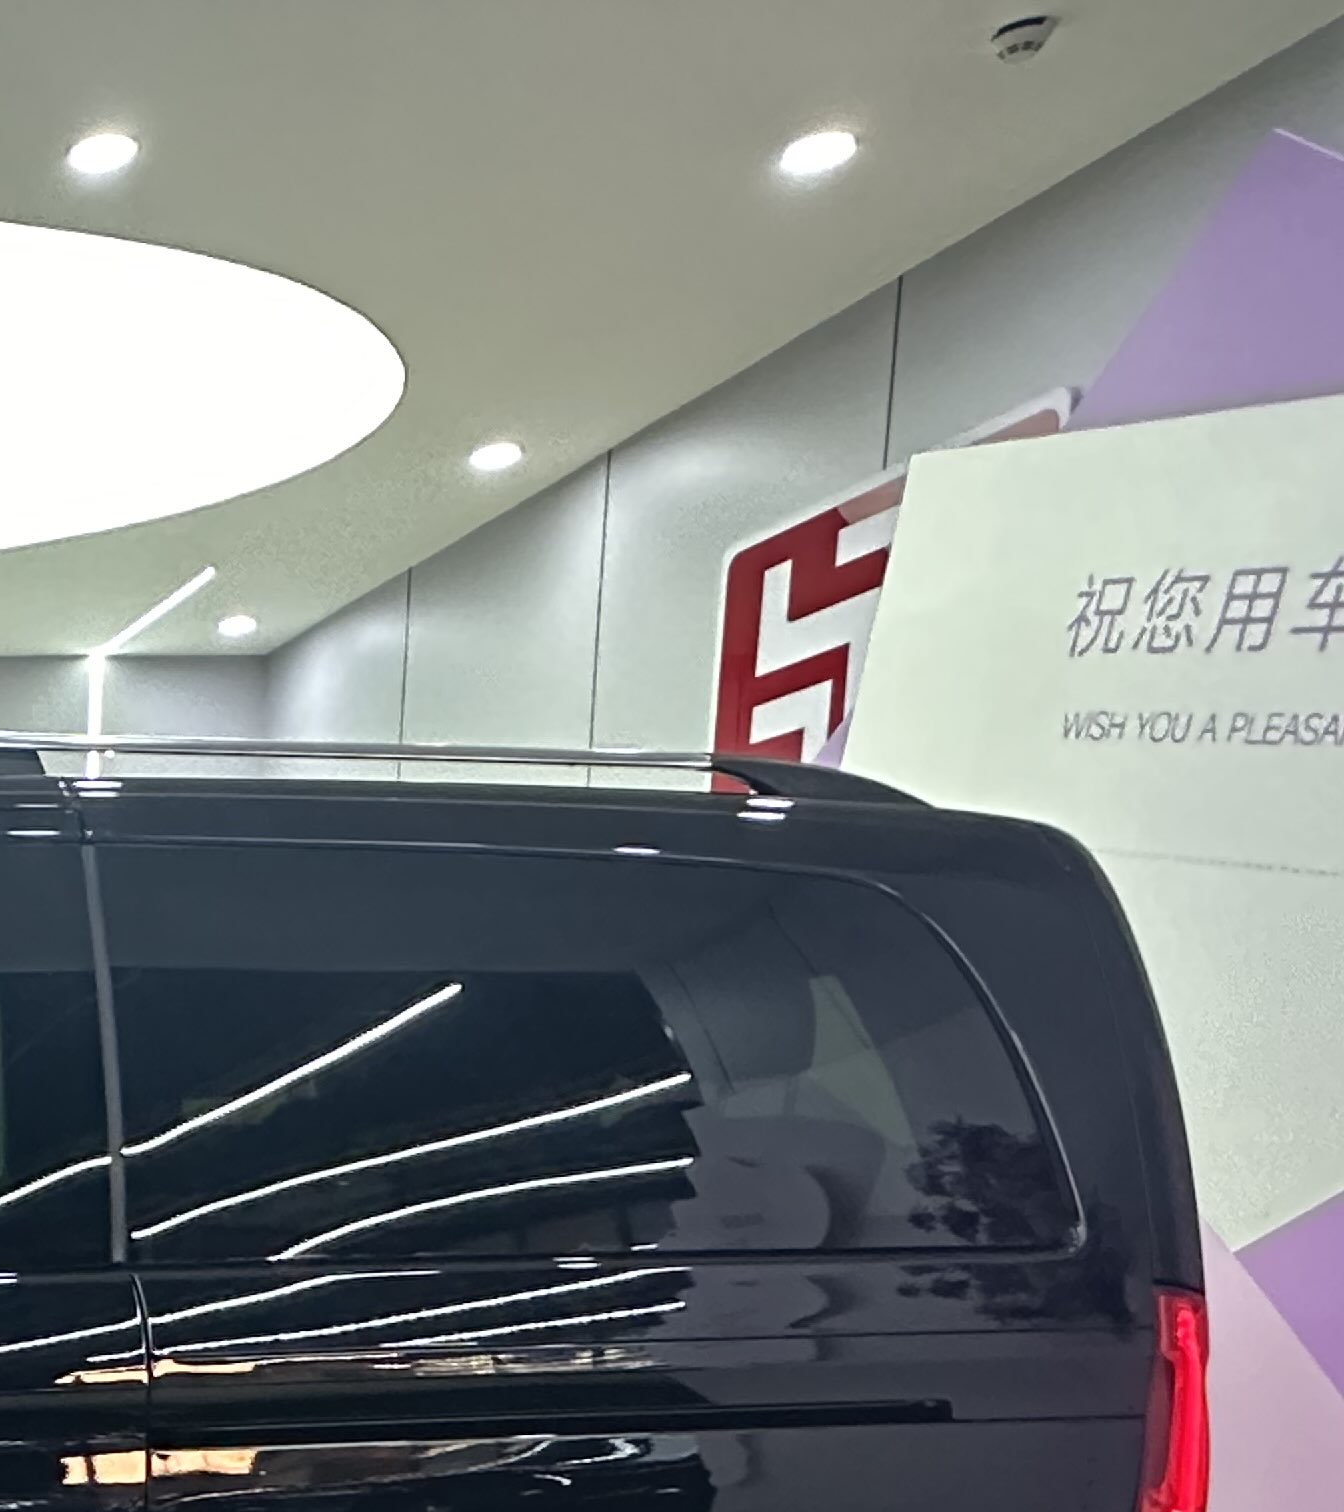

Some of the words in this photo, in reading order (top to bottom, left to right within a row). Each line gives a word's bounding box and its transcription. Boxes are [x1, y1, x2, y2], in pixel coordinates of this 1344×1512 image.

[1066, 556, 1344, 657] 祝您用车
[1063, 711, 1127, 741] WISH
[1137, 711, 1193, 743] YOU
[1198, 712, 1217, 742] A
[1227, 711, 1344, 746] PLEASA
